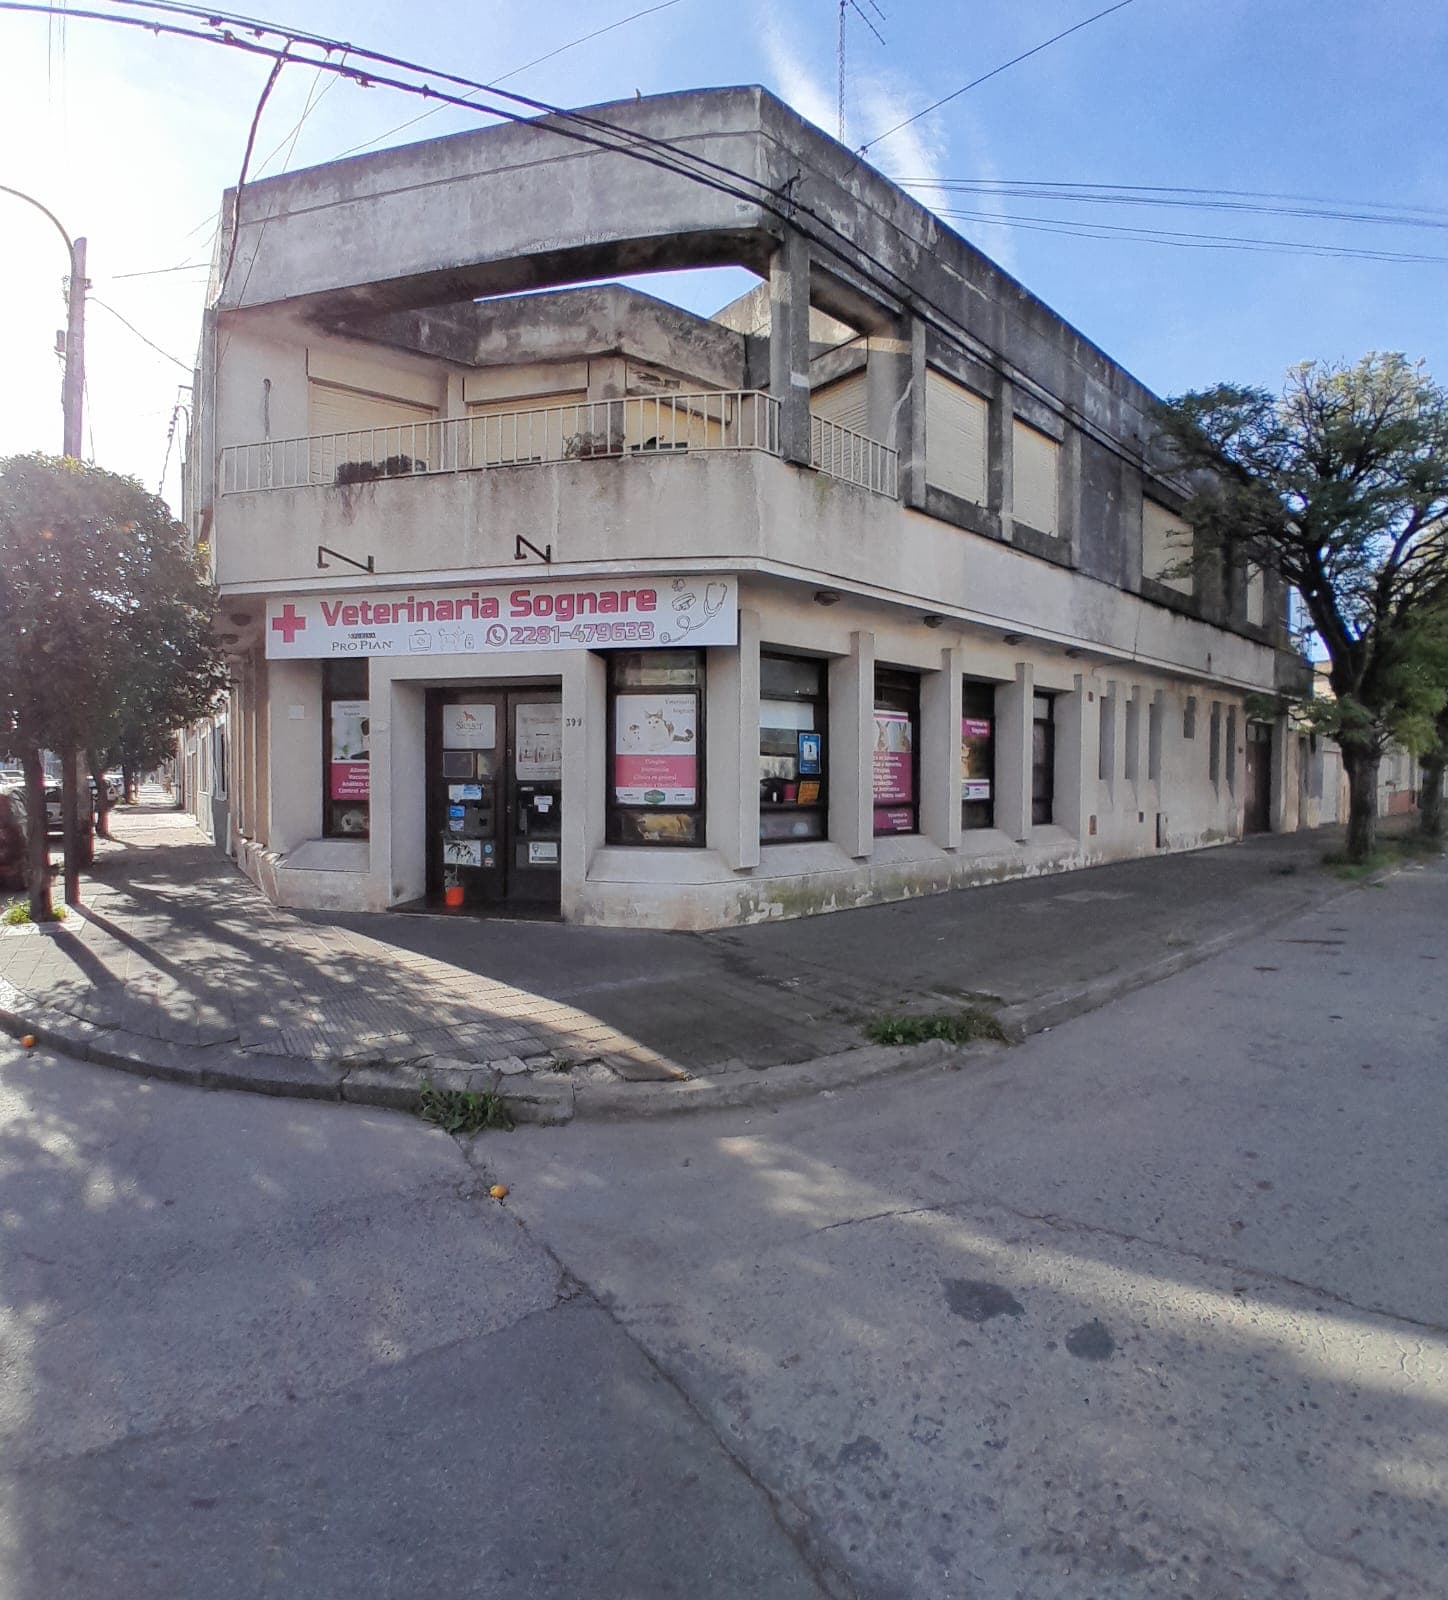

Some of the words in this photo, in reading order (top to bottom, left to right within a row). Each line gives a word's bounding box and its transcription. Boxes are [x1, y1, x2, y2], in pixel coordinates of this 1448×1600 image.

[320, 592, 500, 627] Veterinaria
[510, 589, 657, 622] Sognare
[510, 621, 655, 645] 2281-479633
[331, 641, 358, 651] PRO
